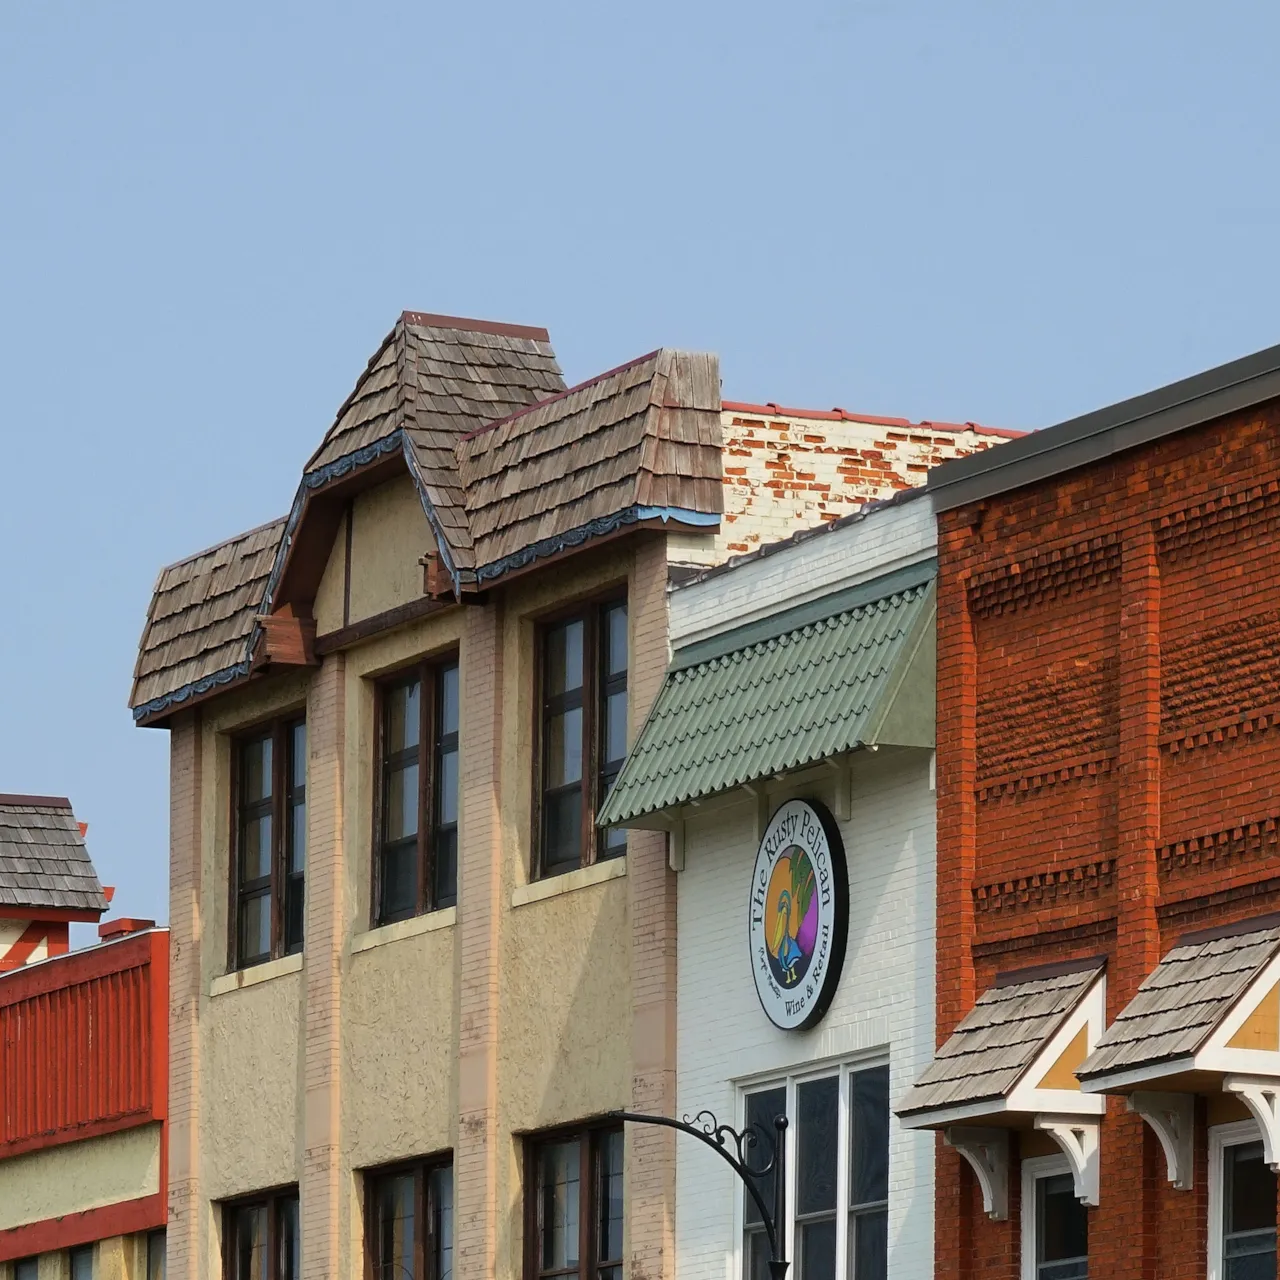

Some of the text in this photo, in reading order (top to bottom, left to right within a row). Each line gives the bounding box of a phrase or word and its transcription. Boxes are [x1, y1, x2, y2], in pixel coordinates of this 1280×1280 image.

[752, 809, 831, 931] The Rusty Pelican
[785, 924, 830, 1017] Wine & Retail
